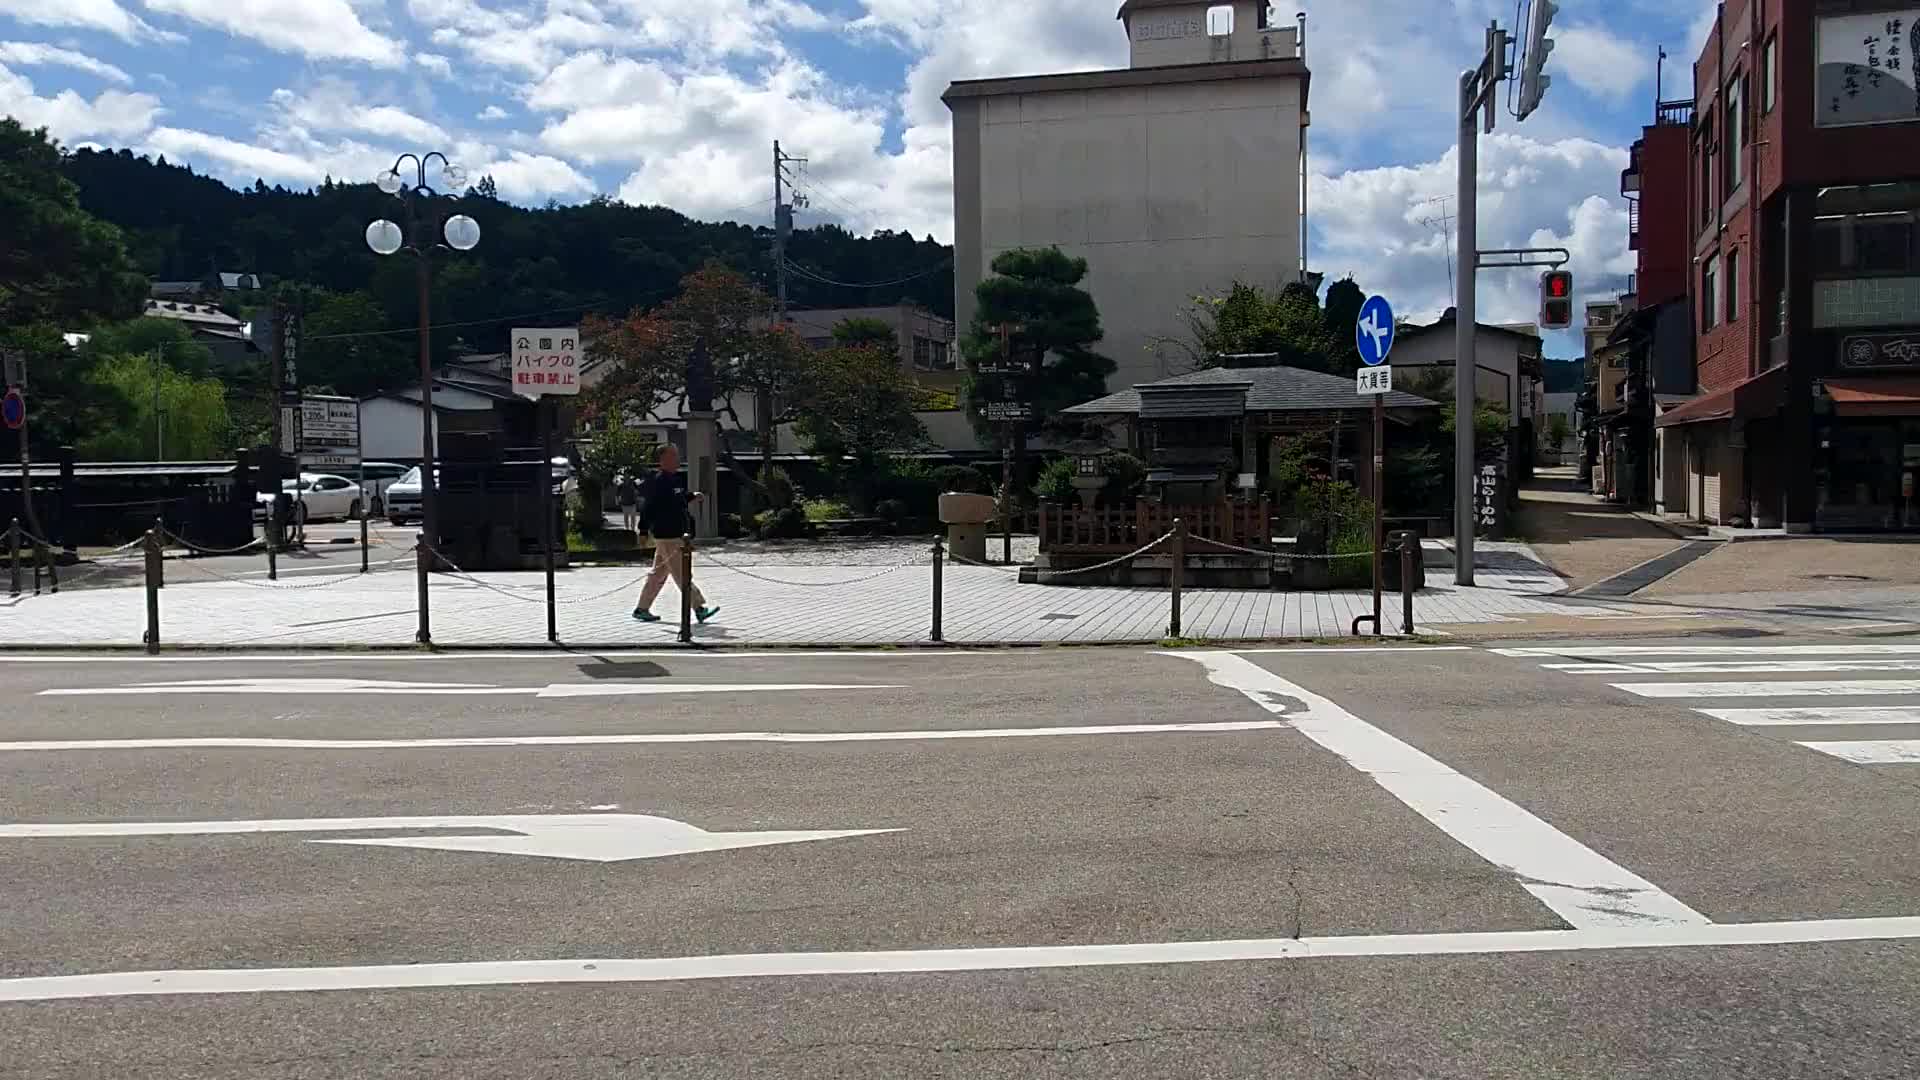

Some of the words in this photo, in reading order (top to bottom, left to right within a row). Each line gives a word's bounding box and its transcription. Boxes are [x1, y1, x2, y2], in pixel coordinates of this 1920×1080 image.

[516, 336, 575, 350] 公園内
[516, 355, 575, 368] バイクの
[517, 372, 575, 385] 駐車禁止
[1359, 371, 1389, 390] 大貨等
[1480, 464, 1497, 526] 高山らーめん
